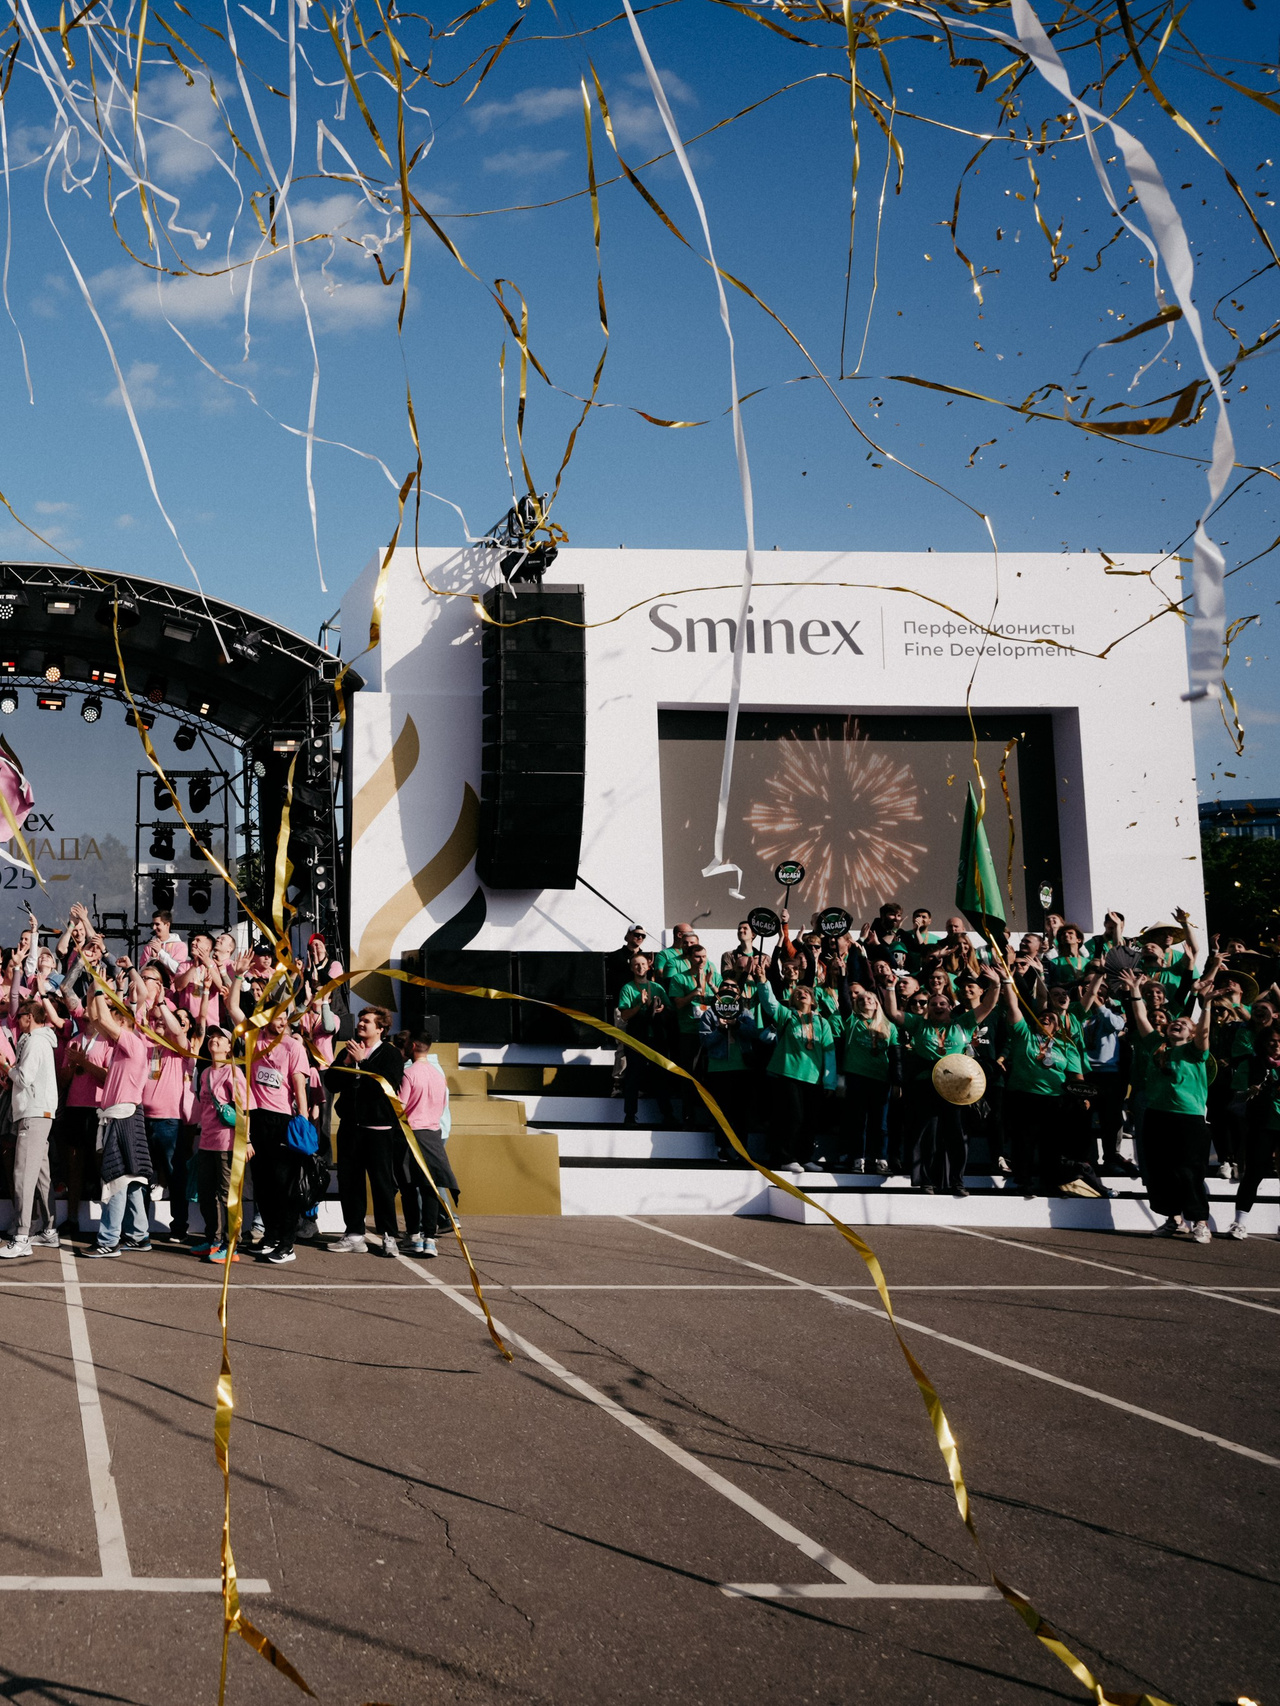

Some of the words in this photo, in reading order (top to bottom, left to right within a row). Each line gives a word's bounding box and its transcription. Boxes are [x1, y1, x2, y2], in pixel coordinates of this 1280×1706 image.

[649, 603, 864, 655] Sminex
[903, 620, 1075, 637] Перфекционисты
[904, 642, 944, 656] Fine
[950, 642, 1076, 659] Development
[821, 920, 847, 930] ВАСАБИ
